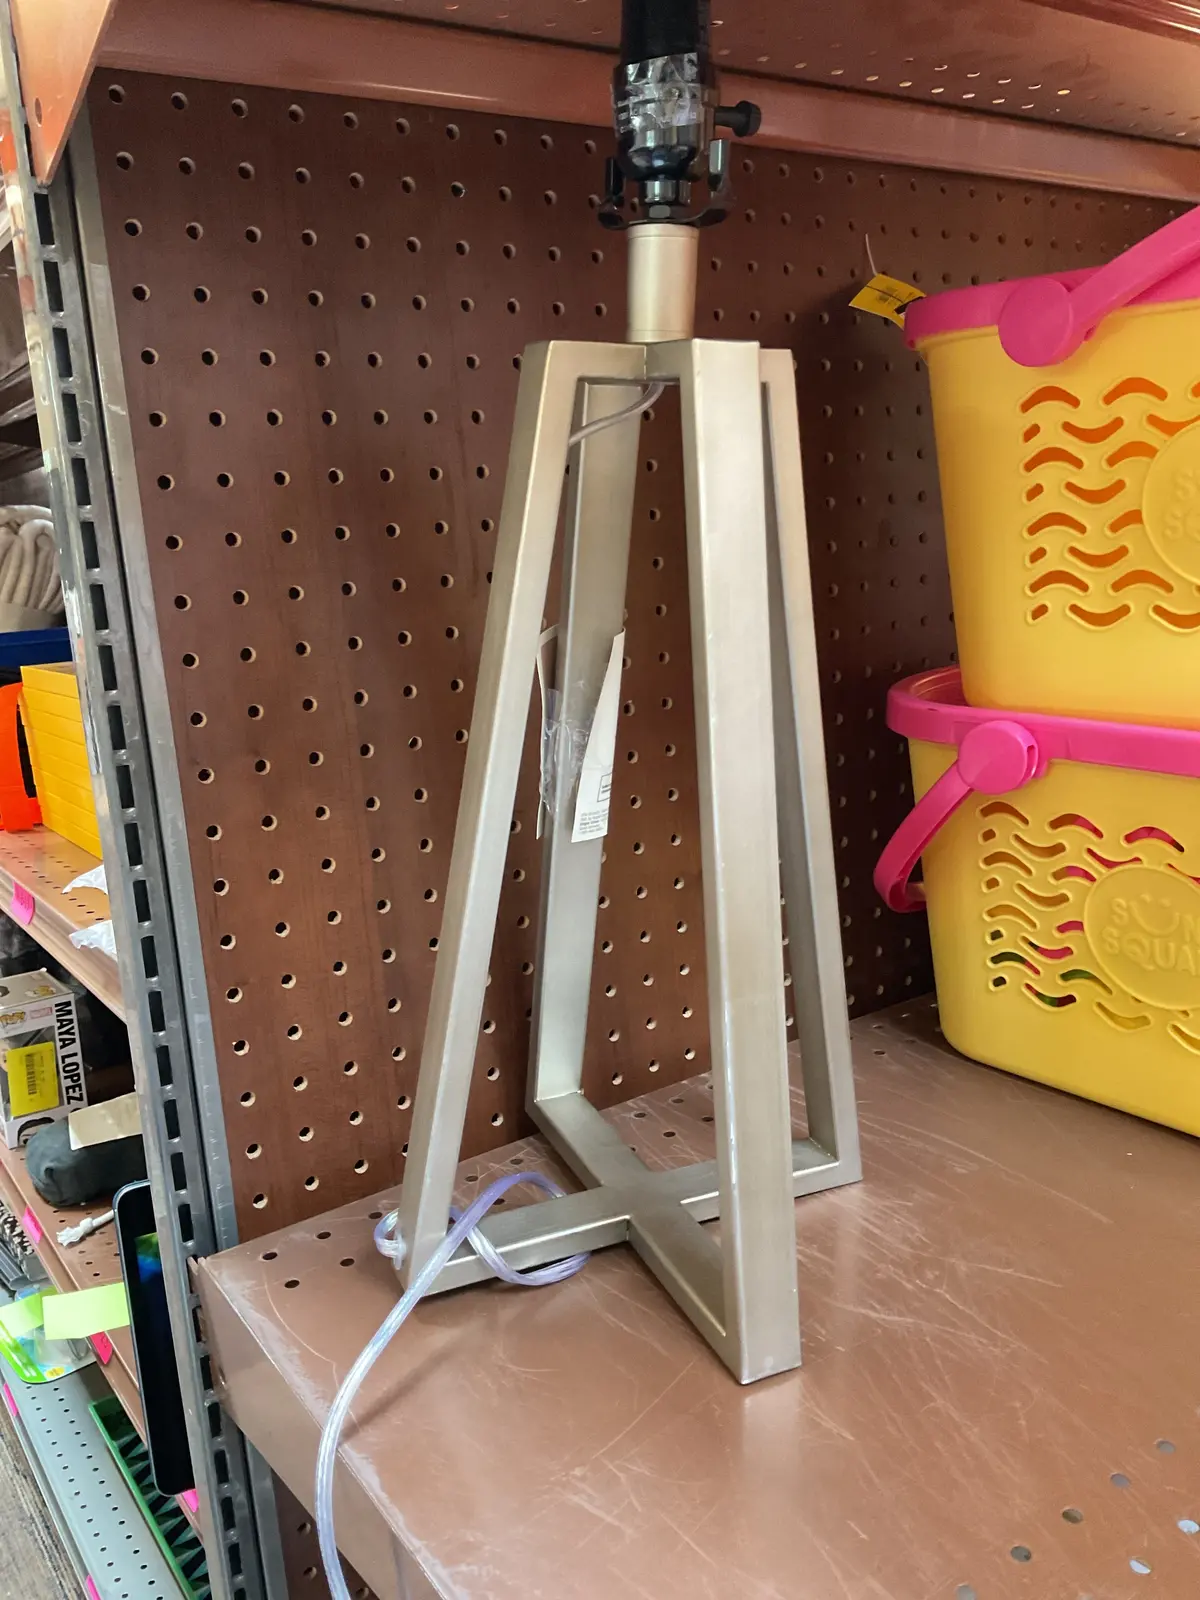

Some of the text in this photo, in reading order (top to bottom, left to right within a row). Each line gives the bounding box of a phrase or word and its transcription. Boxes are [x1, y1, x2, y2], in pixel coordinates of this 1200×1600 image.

[1101, 925, 1200, 976] SQUA
[55, 1000, 76, 1049] MAYA
[61, 1052, 84, 1105] LOPEZ
